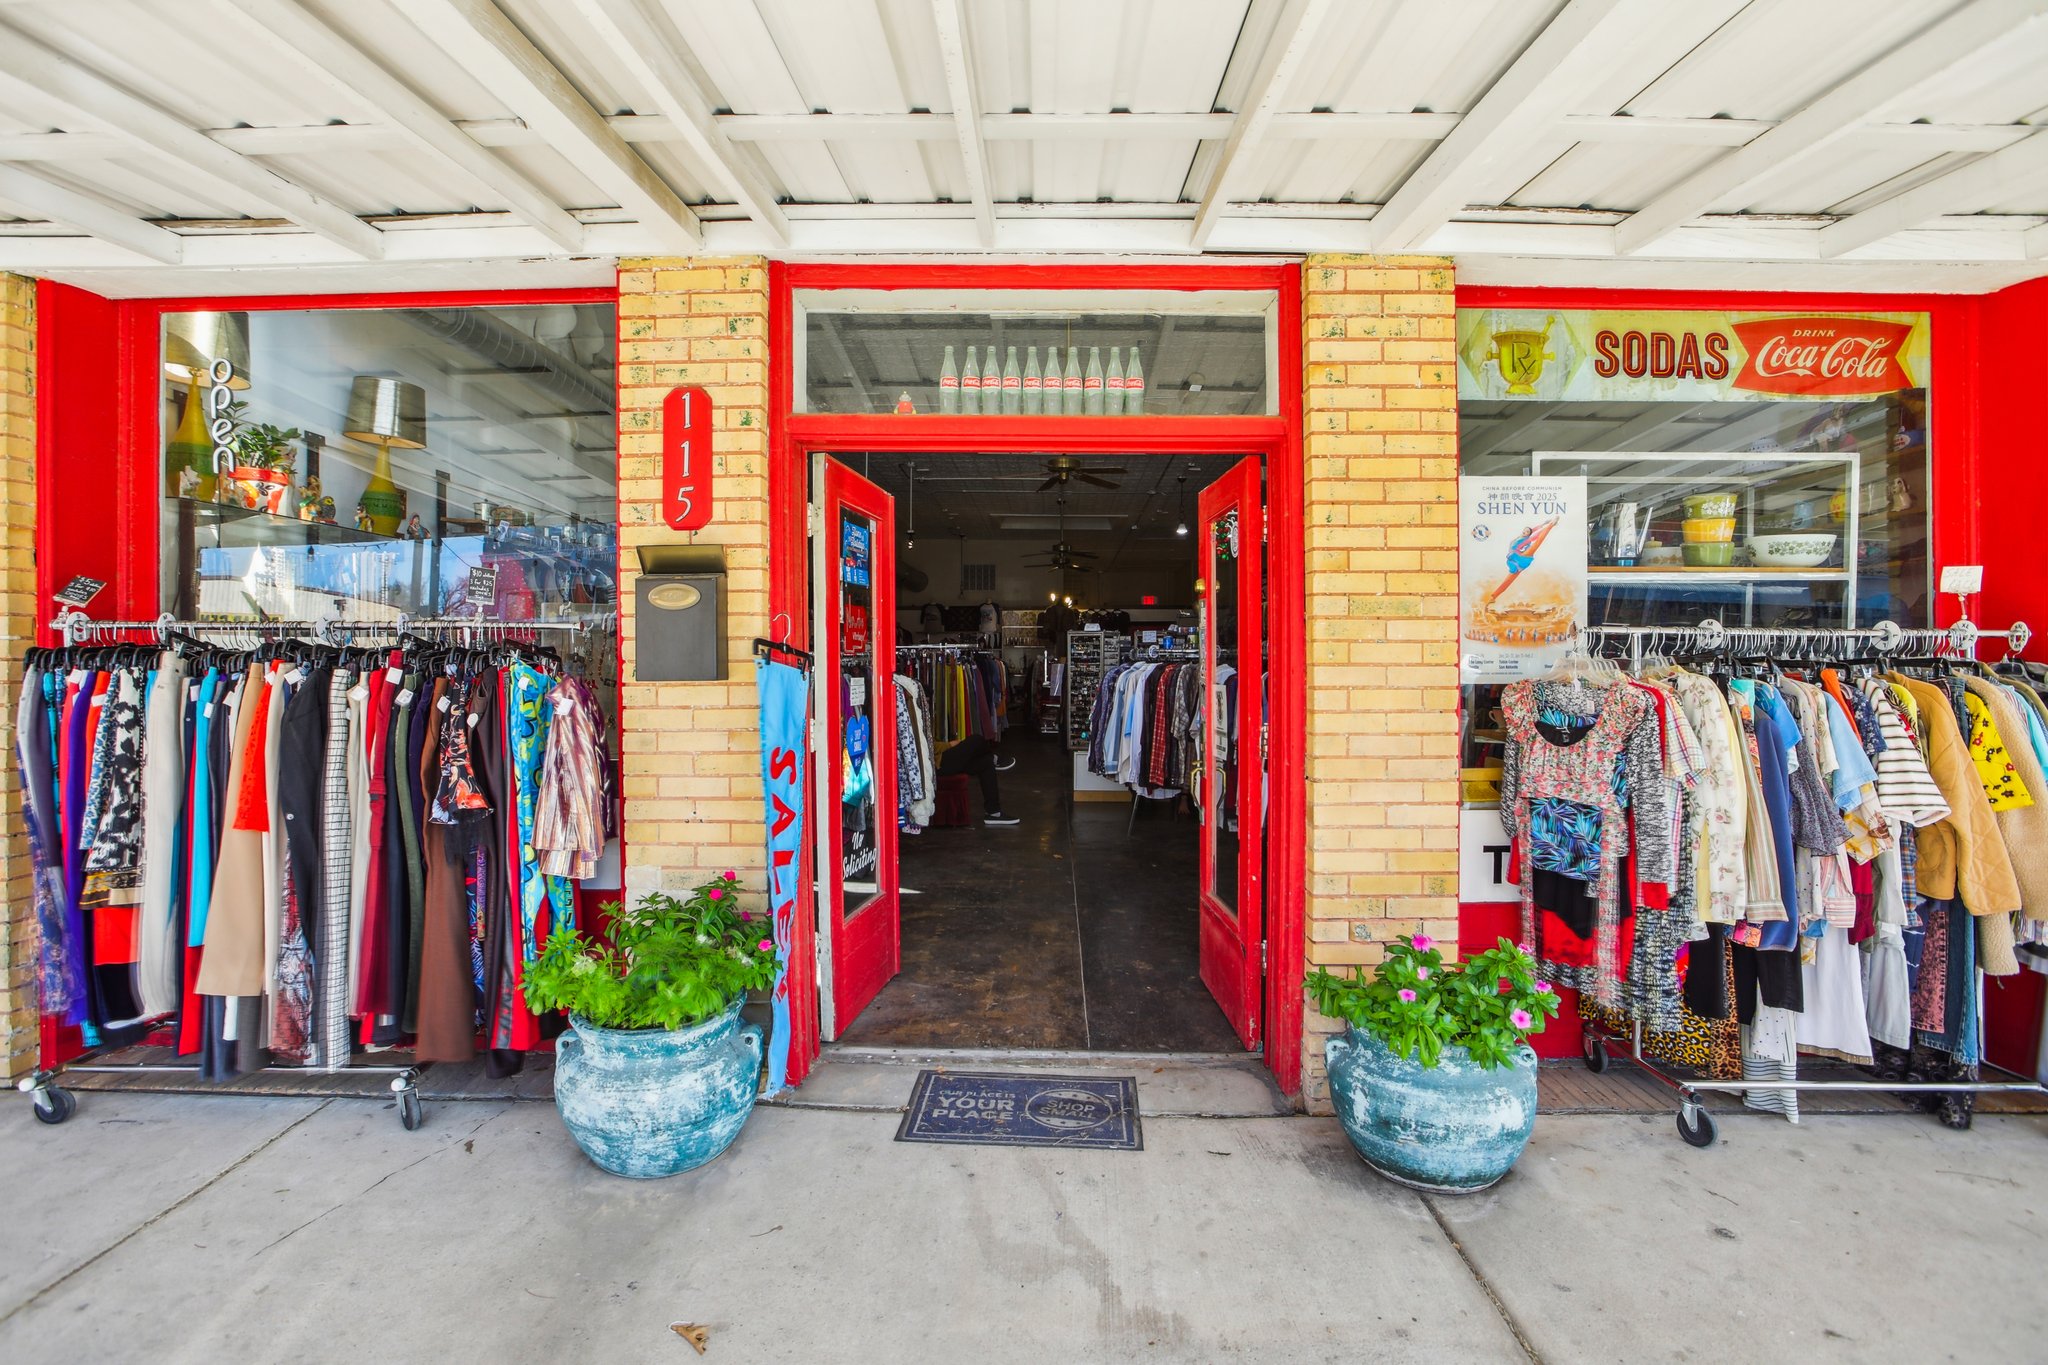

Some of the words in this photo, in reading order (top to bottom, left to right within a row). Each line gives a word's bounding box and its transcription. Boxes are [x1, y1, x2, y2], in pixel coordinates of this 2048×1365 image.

[1792, 329, 1836, 337] DRINK
[1594, 330, 1729, 380] SODAS
[1755, 335, 1893, 378] Coca-Cola
[209, 358, 235, 474] open
[675, 391, 695, 522] 115
[1537, 492, 1557, 501] 2025
[1477, 501, 1525, 515] SHEN
[1530, 501, 1567, 515] YUN
[851, 831, 865, 850] No
[843, 847, 877, 880] Soliciting
[938, 1096, 1015, 1111] YOUR
[1046, 1100, 1096, 1111] SHOP
[932, 1109, 1014, 1120] PLACE
[1038, 1108, 1097, 1119] SMALL
